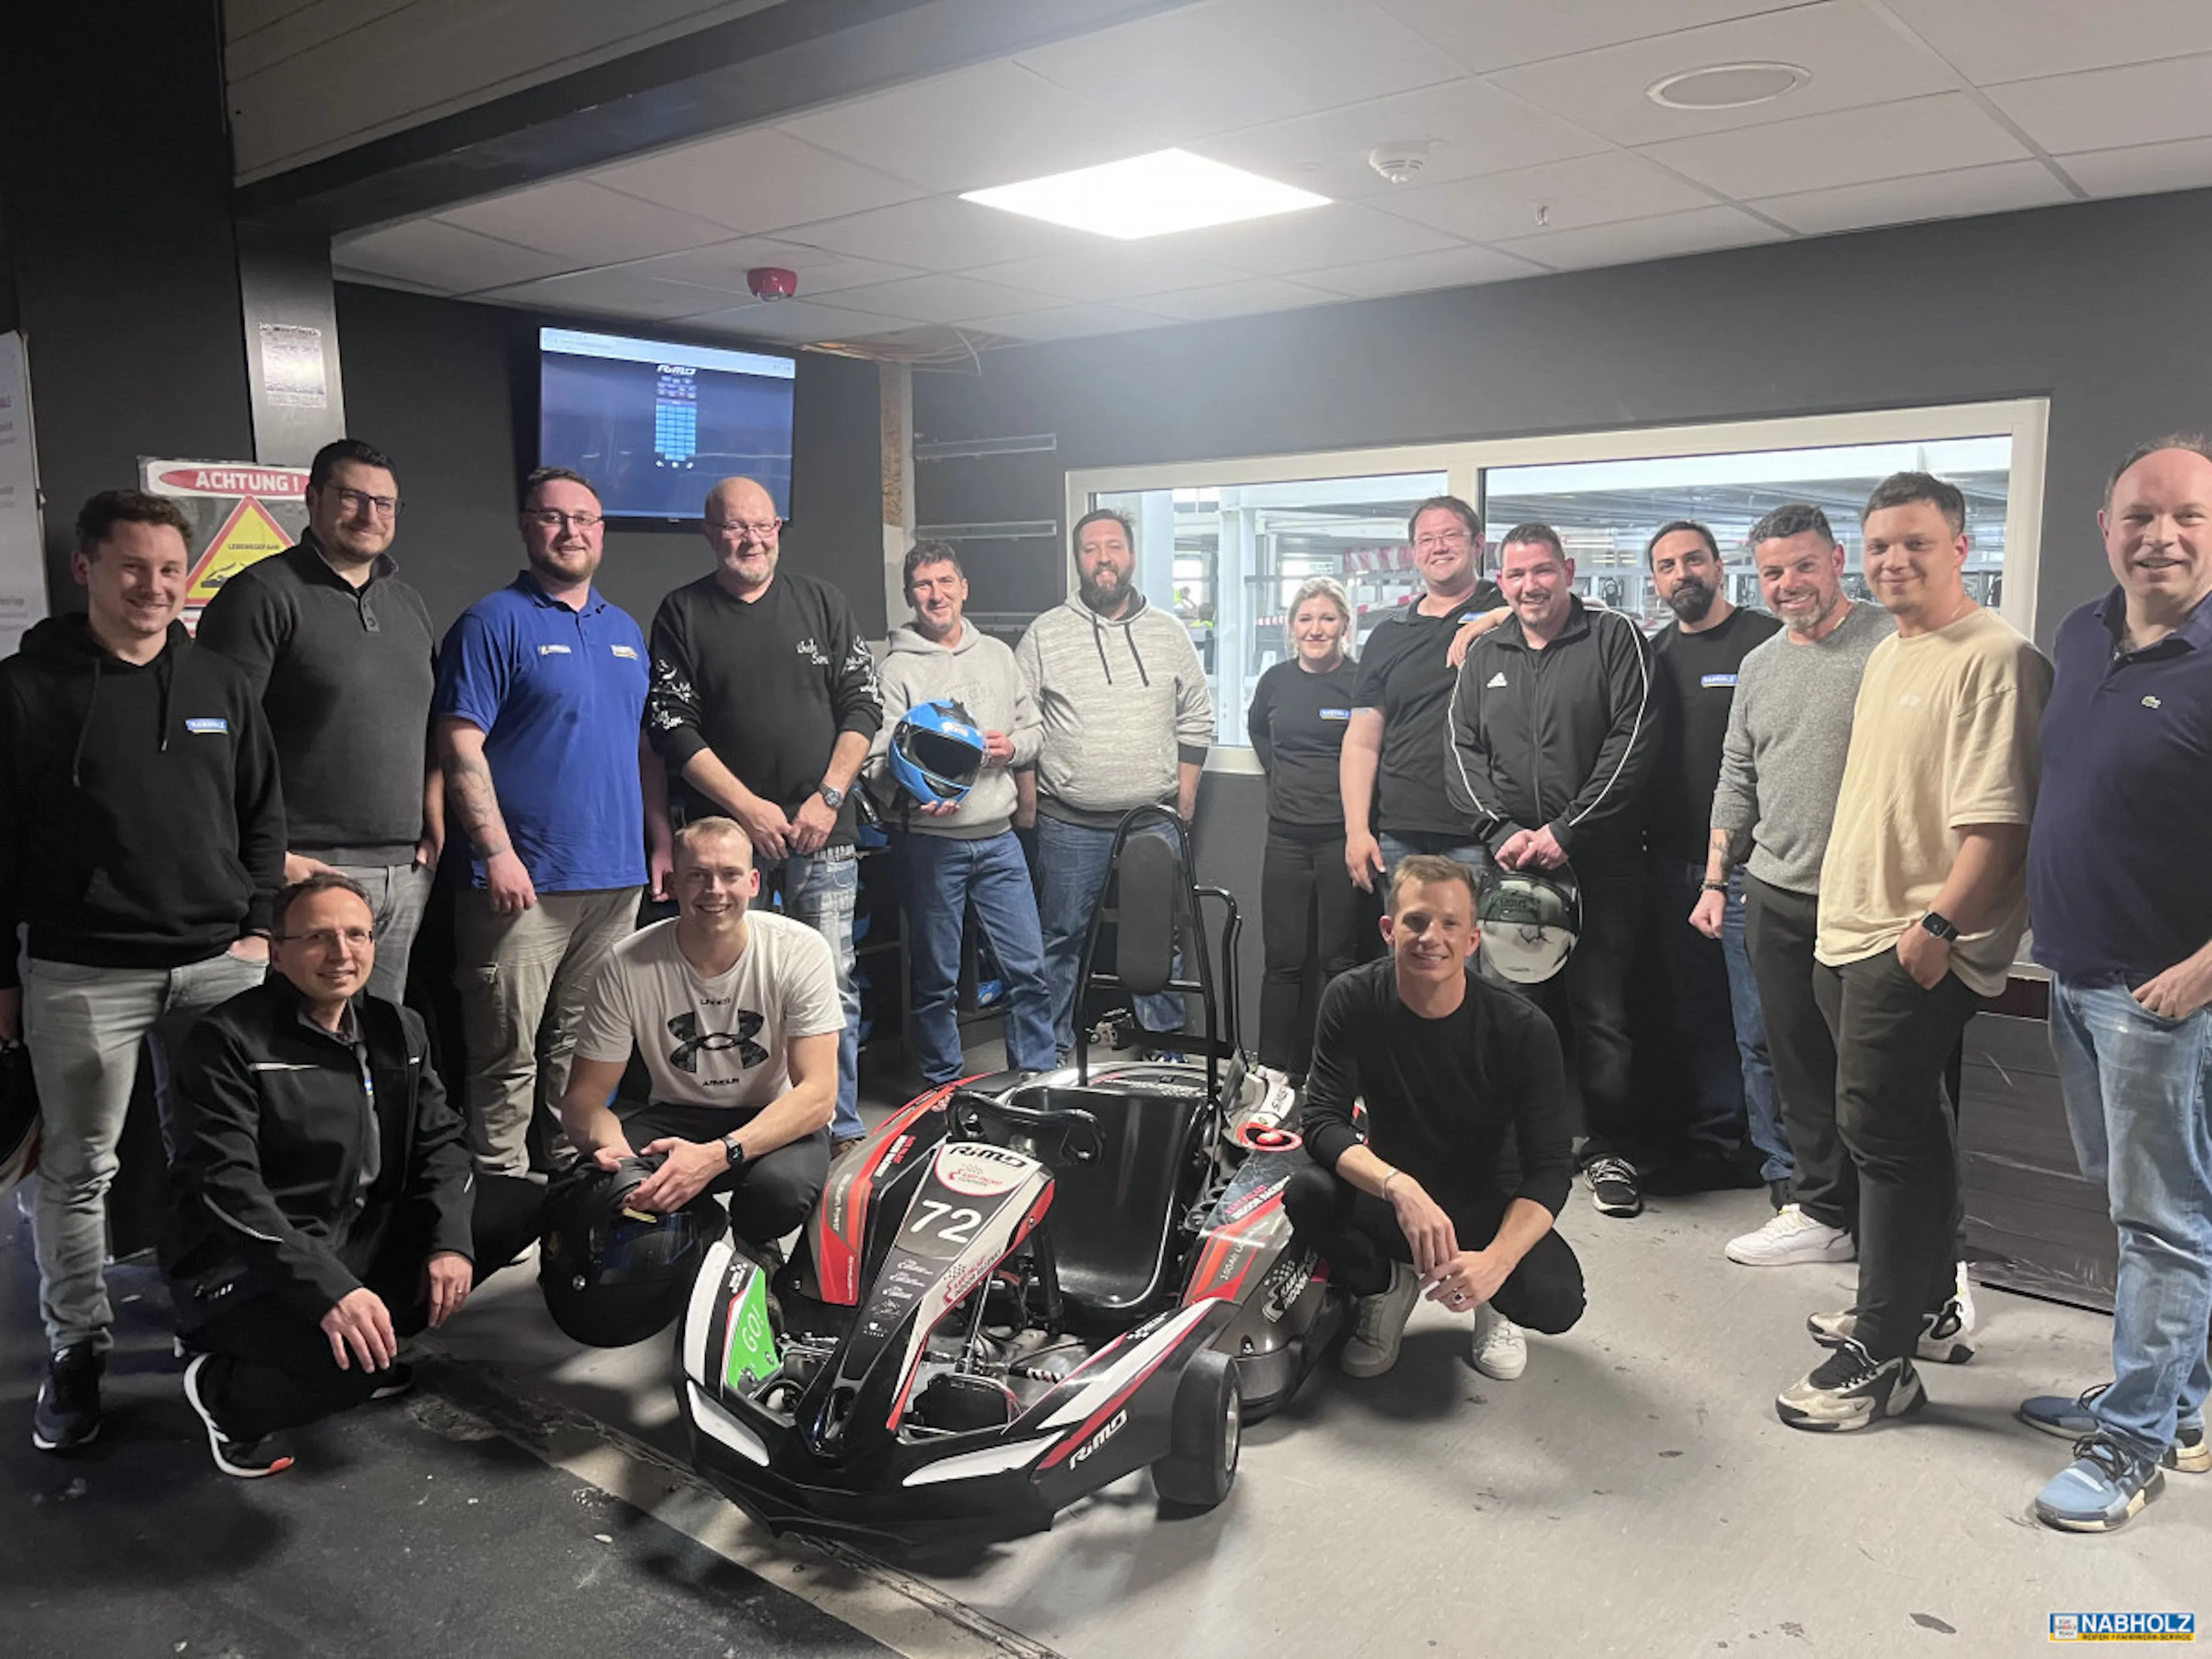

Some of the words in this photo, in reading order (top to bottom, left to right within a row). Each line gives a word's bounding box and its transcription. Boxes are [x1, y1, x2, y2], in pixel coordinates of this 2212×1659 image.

[195, 471, 288, 492] ACHTUNG
[702, 1078, 740, 1086] ARMOUR
[910, 1199, 982, 1244] 72
[742, 1303, 765, 1353] GO!
